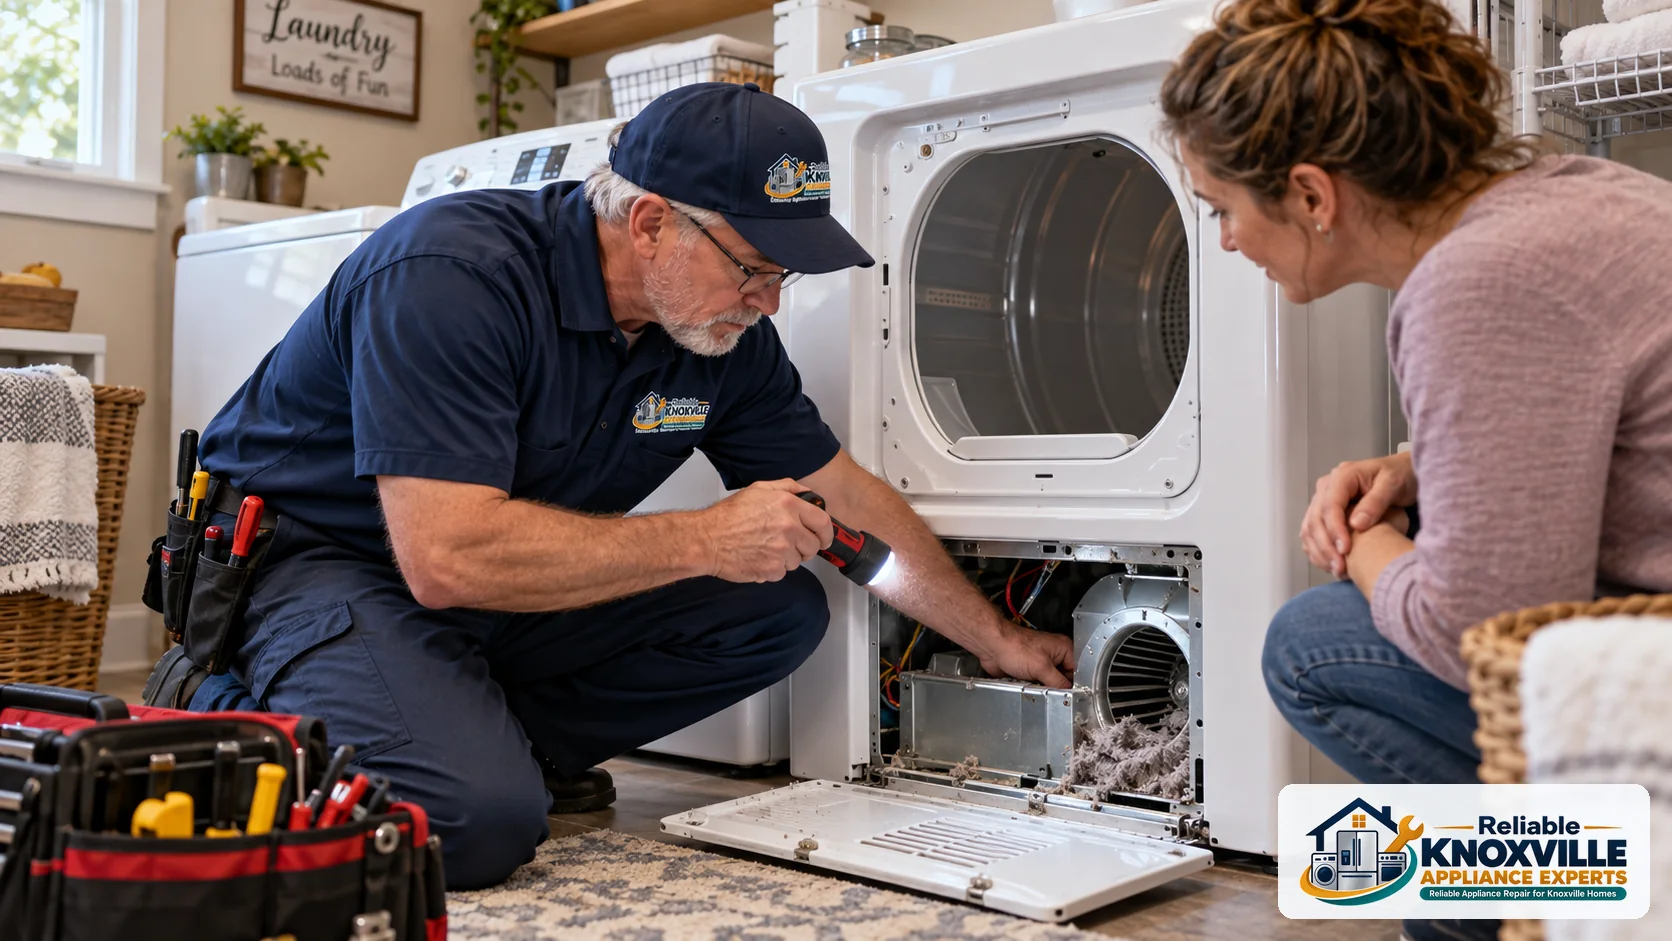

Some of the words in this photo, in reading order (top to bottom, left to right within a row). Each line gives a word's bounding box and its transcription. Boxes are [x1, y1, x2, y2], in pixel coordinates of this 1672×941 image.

[262, 0, 396, 72] Laundry
[271, 53, 324, 85] Loads
[330, 65, 351, 96] of
[357, 70, 390, 98] Fun
